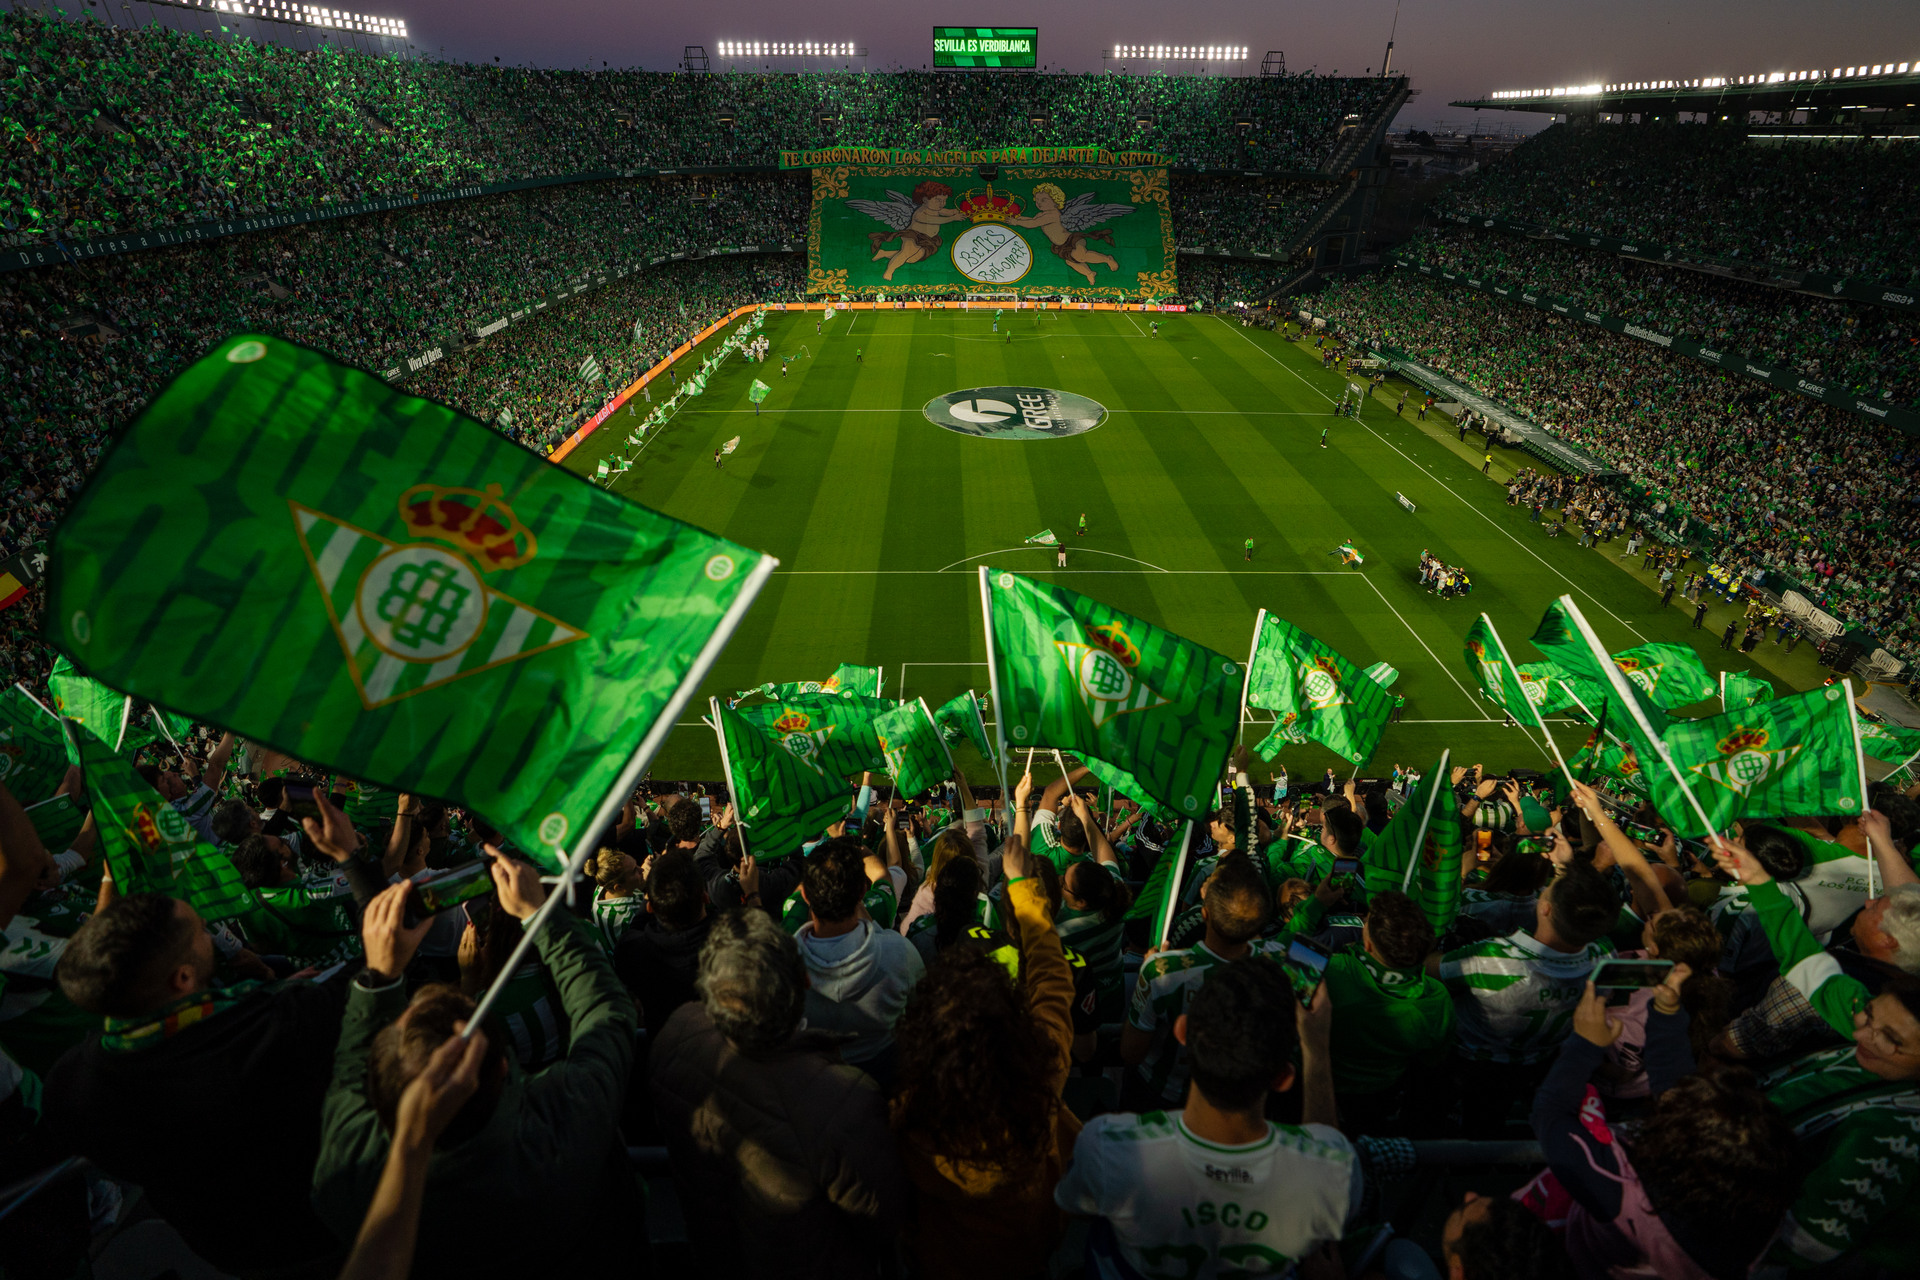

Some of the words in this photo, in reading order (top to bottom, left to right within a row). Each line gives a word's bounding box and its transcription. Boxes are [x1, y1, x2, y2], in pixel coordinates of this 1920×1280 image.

[934, 39, 966, 52] SEVILLA
[967, 40, 978, 52] ES
[979, 40, 1031, 53] VERDIBLANCA
[781, 151, 801, 167] TE
[802, 147, 892, 165] CORONARON
[894, 150, 922, 165] LOS
[990, 149, 1028, 164] PARA
[1031, 148, 1096, 164] DEJARTE
[1096, 148, 1117, 165] EN
[19, 250, 45, 266] De
[217, 222, 234, 235] de
[959, 229, 1006, 267] BETIS
[1882, 291, 1908, 304] asisa
[407, 355, 423, 372] Viva
[422, 351, 430, 366] el
[427, 346, 444, 363] Betis
[1705, 350, 1723, 361] GREE
[386, 366, 401, 378] GREE
[1804, 383, 1827, 395] GREE
[1016, 393, 1053, 430] GREE
[1818, 880, 1844, 891] LOS
[1539, 987, 1582, 1003] PAP
[1181, 1201, 1269, 1231] ISCO
